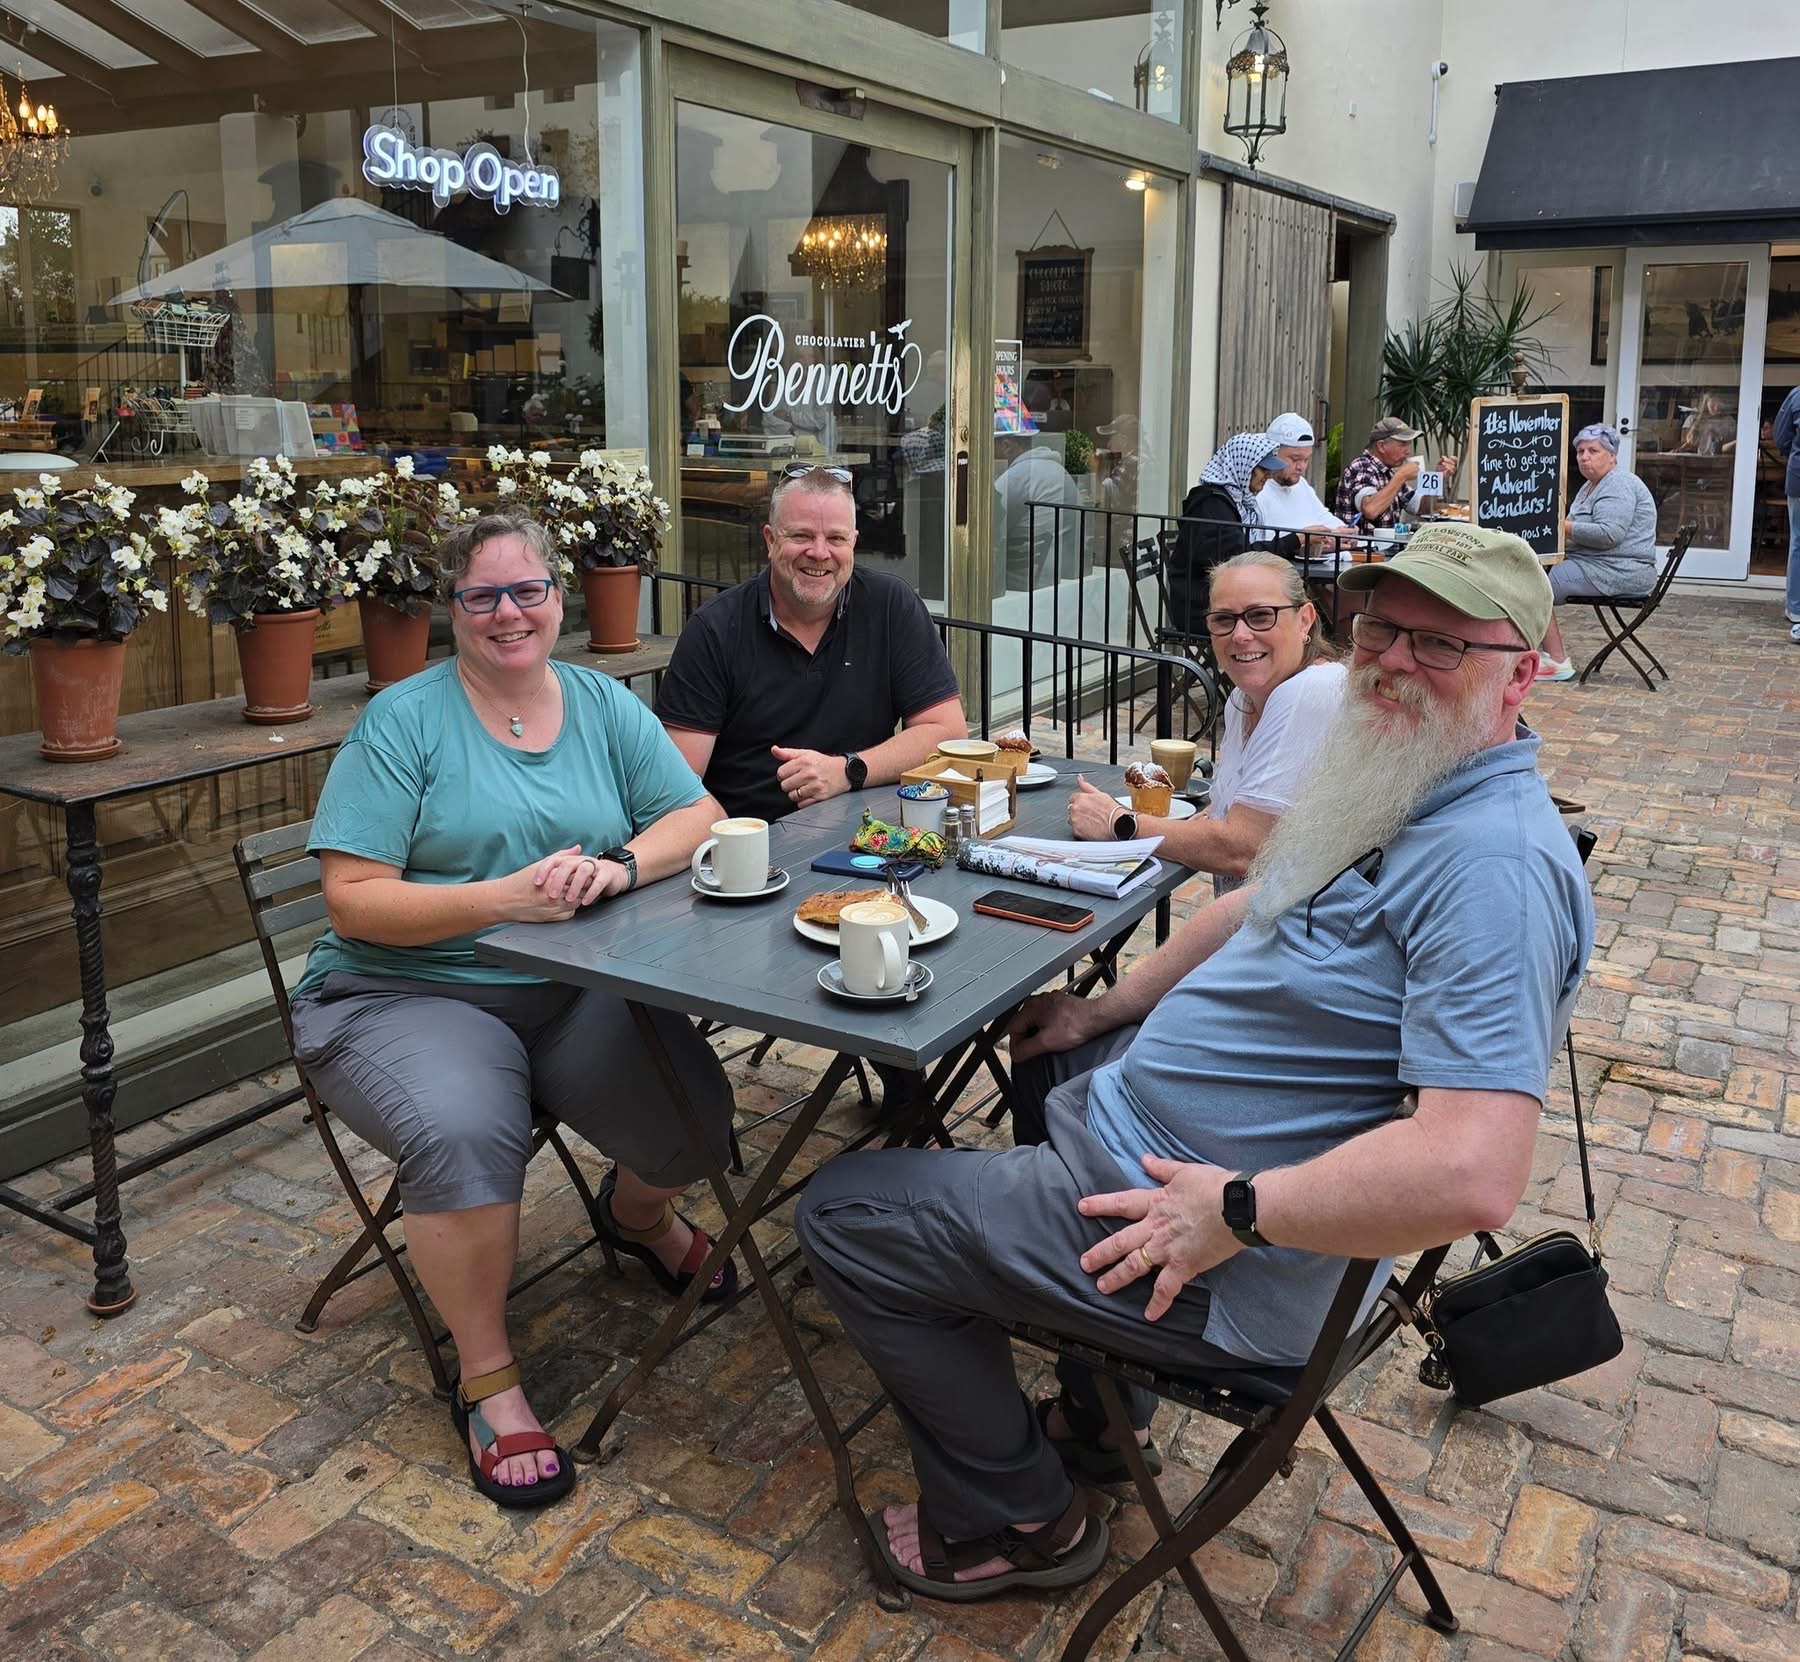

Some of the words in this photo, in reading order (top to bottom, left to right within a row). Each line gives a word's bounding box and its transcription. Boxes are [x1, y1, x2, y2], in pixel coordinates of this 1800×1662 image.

[371, 131, 465, 198] Shop
[470, 152, 560, 206] Open
[795, 334, 865, 348] CHOCOLATIER
[1483, 411, 1507, 435] It's
[1508, 408, 1561, 434] November
[1480, 453, 1503, 472] Time
[1504, 452, 1517, 470] to
[1520, 449, 1538, 472] get
[1536, 455, 1557, 475] your
[1422, 473, 1439, 490] 26
[1491, 469, 1540, 495] Advent
[1521, 526, 1540, 539] now
[1446, 548, 1469, 562] PARK
